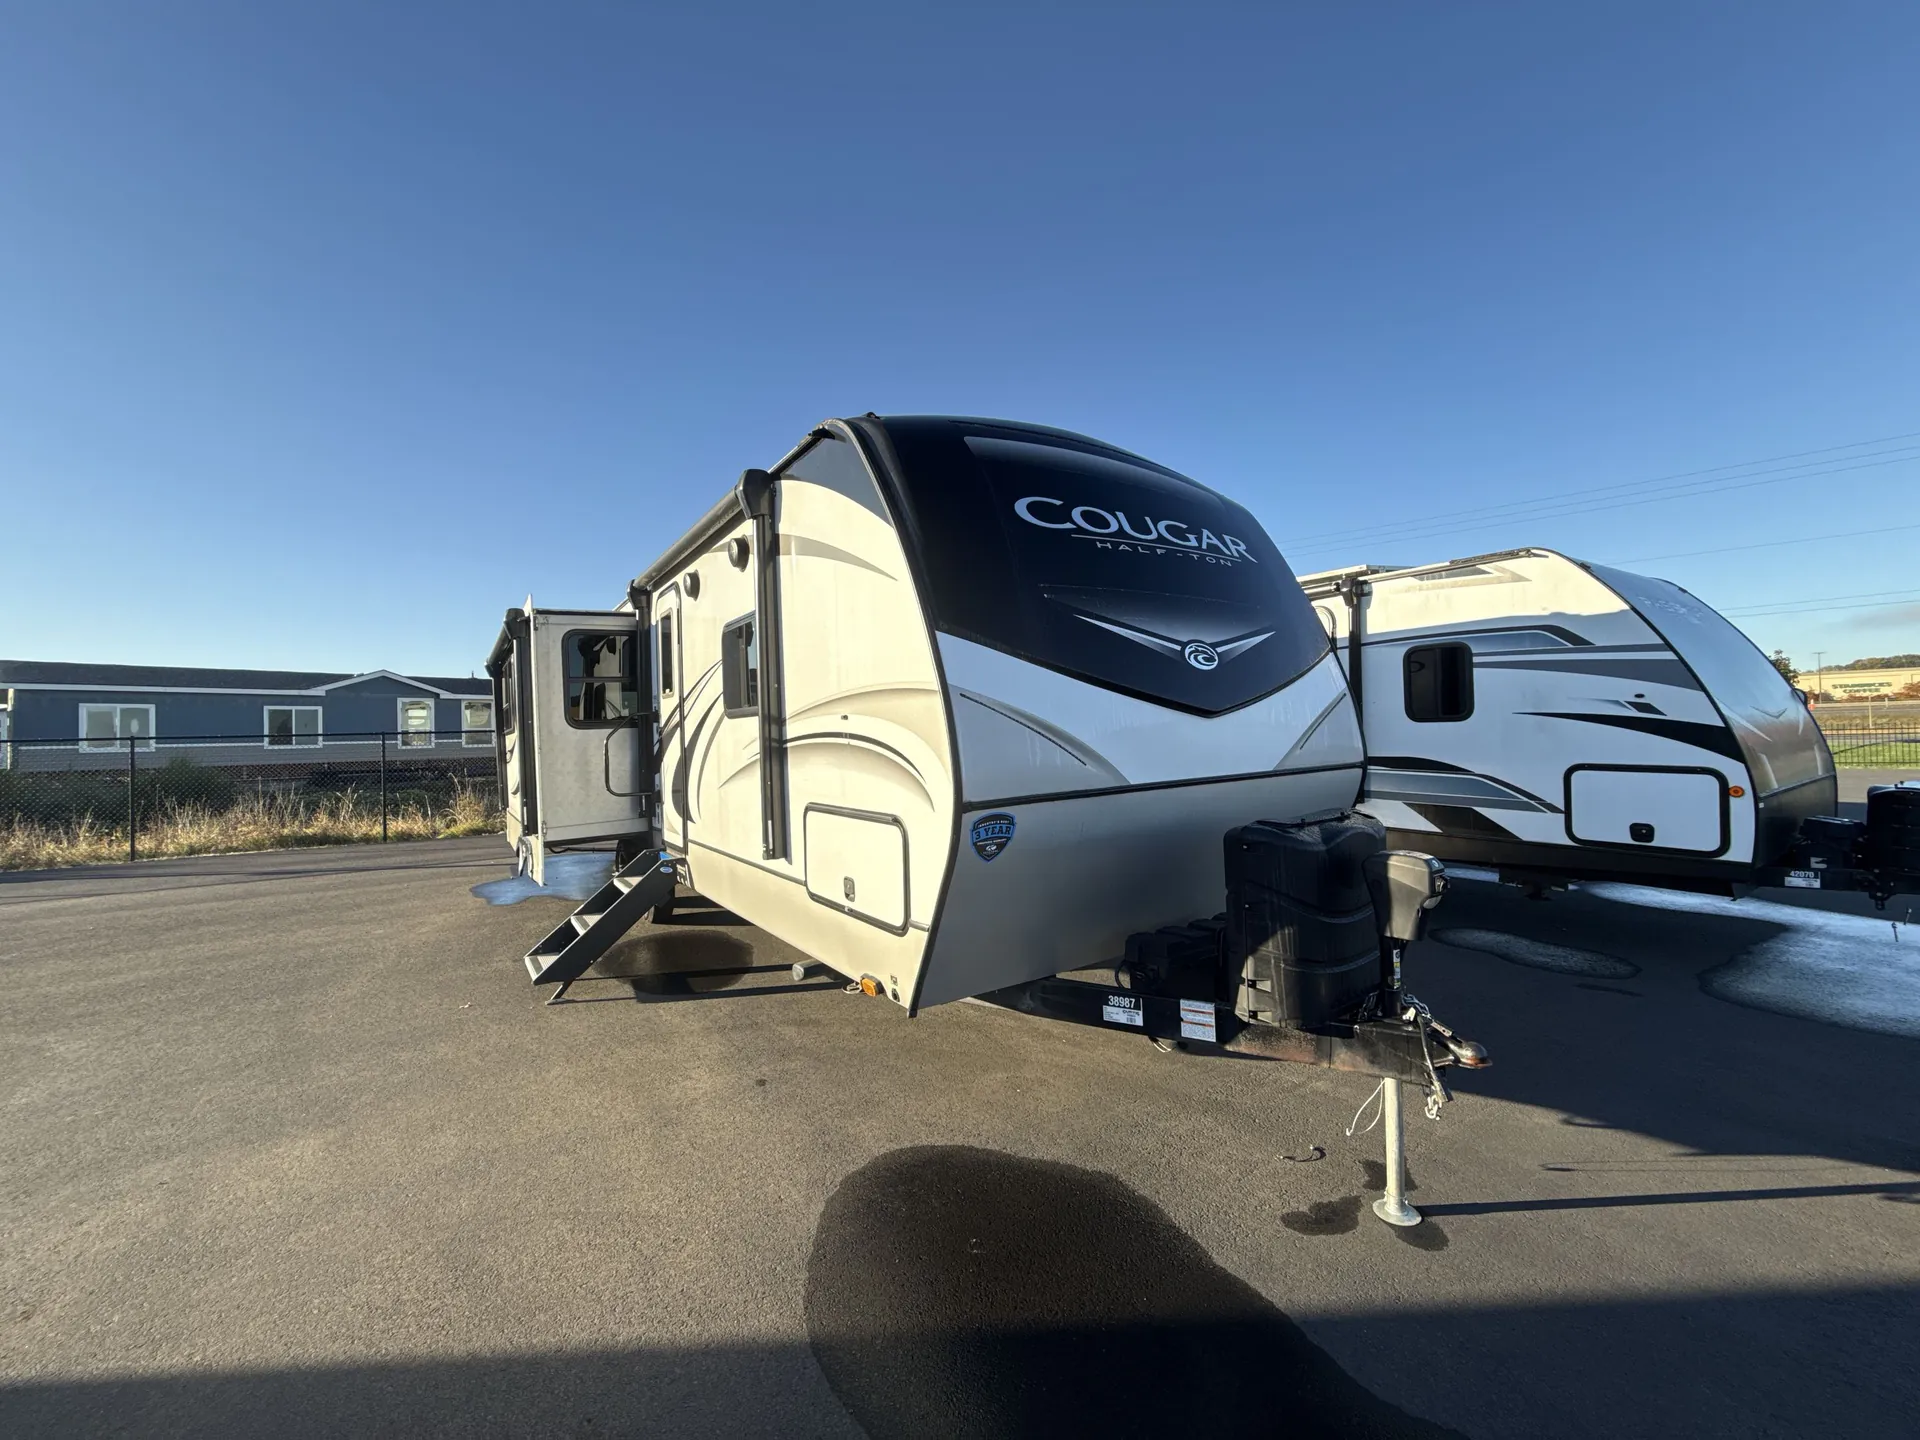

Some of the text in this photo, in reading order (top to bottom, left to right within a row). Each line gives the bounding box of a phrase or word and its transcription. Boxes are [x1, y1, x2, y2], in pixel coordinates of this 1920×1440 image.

[1014, 496, 1258, 564] COUGAR
[974, 825, 1012, 840] 3 YEAR
[1108, 995, 1136, 1009] 38987
